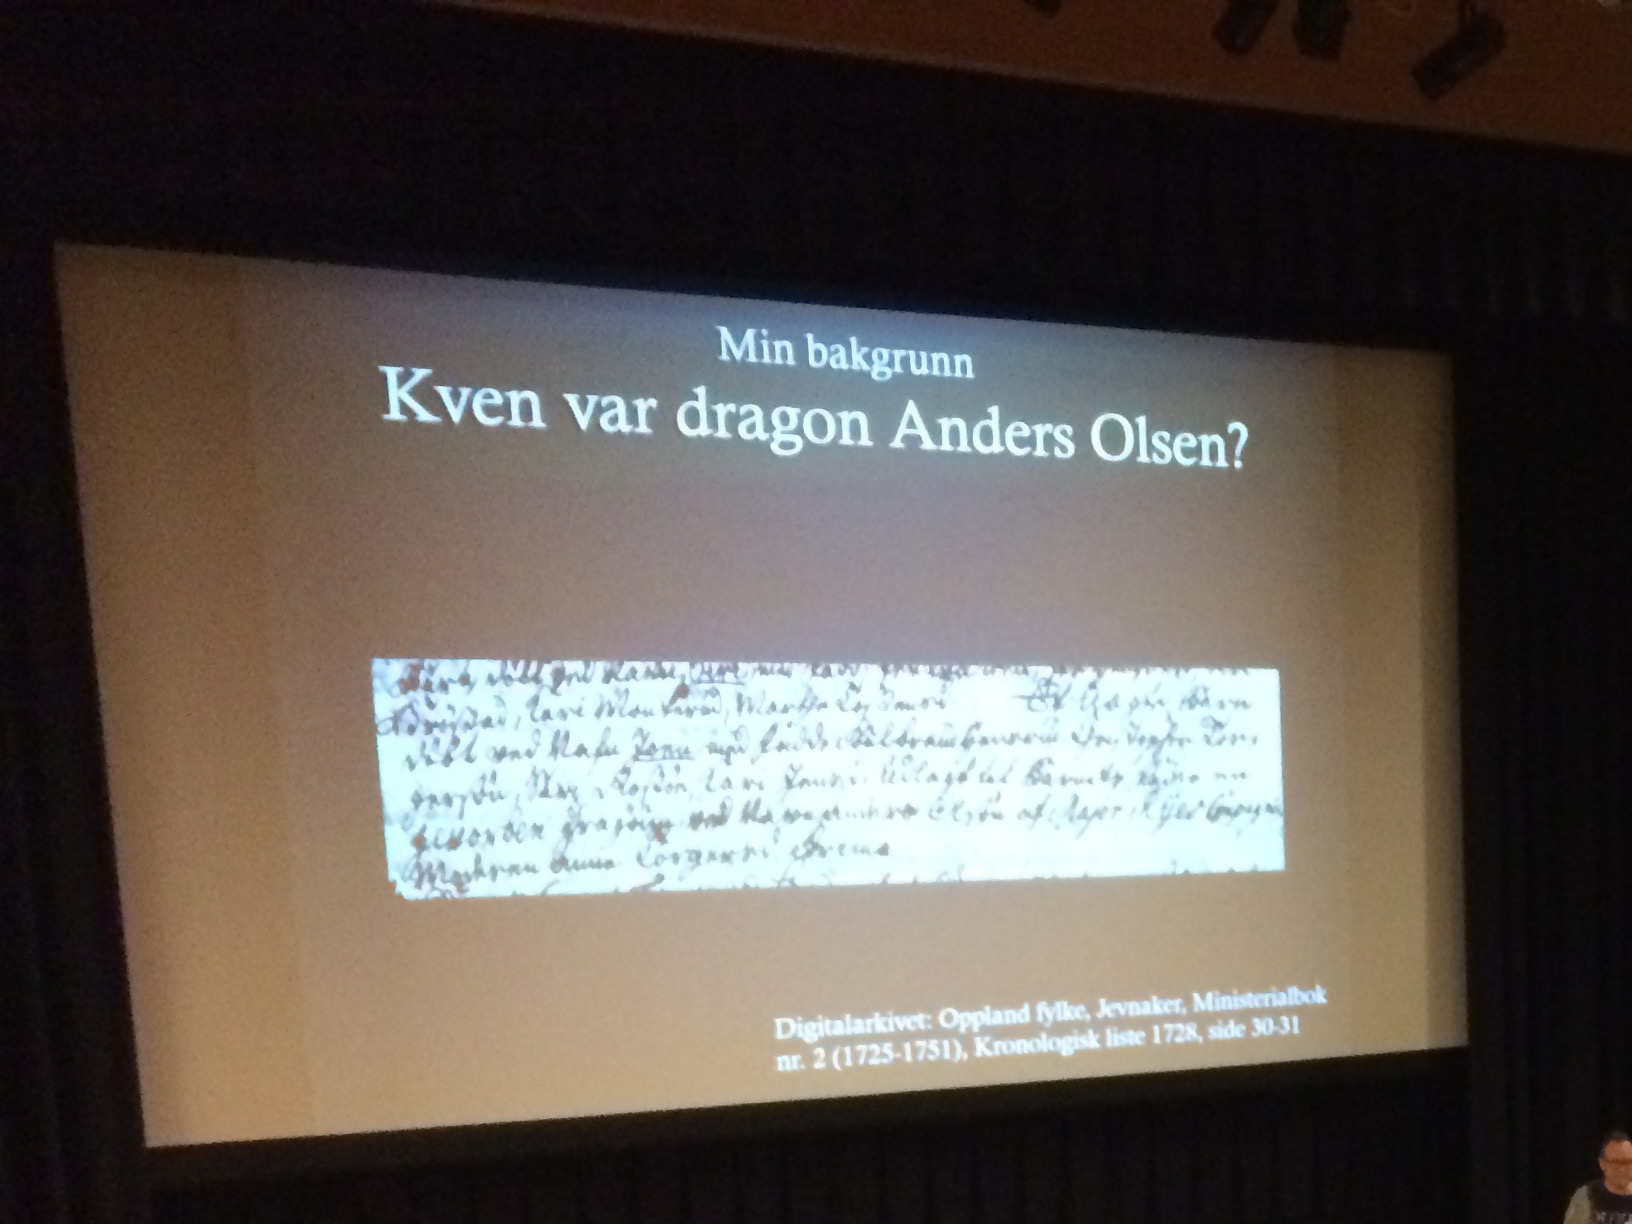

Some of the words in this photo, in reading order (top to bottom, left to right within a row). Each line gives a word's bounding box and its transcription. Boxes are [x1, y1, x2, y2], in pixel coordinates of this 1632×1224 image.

[717, 326, 796, 366] Min
[806, 333, 975, 381] bakgrunn
[379, 366, 547, 429] Kven
[563, 394, 657, 435] var
[677, 385, 873, 456] dragon
[889, 400, 1075, 458] Anders
[1091, 413, 1248, 469] Olsen?
[774, 1014, 931, 1042] Digitalarkivet:
[938, 1004, 1030, 1030] Oppland
[1036, 1001, 1090, 1025] fylke,
[1192, 985, 1327, 1012] Ministerialbok
[776, 1055, 805, 1071] nr.
[814, 1048, 825, 1068] 2
[973, 1030, 1100, 1057] Kronologisk
[1106, 1027, 1145, 1048] liste
[1153, 1023, 1203, 1044] 1728,
[1208, 1021, 1246, 1039] side
[1251, 1016, 1299, 1037] 30-31
